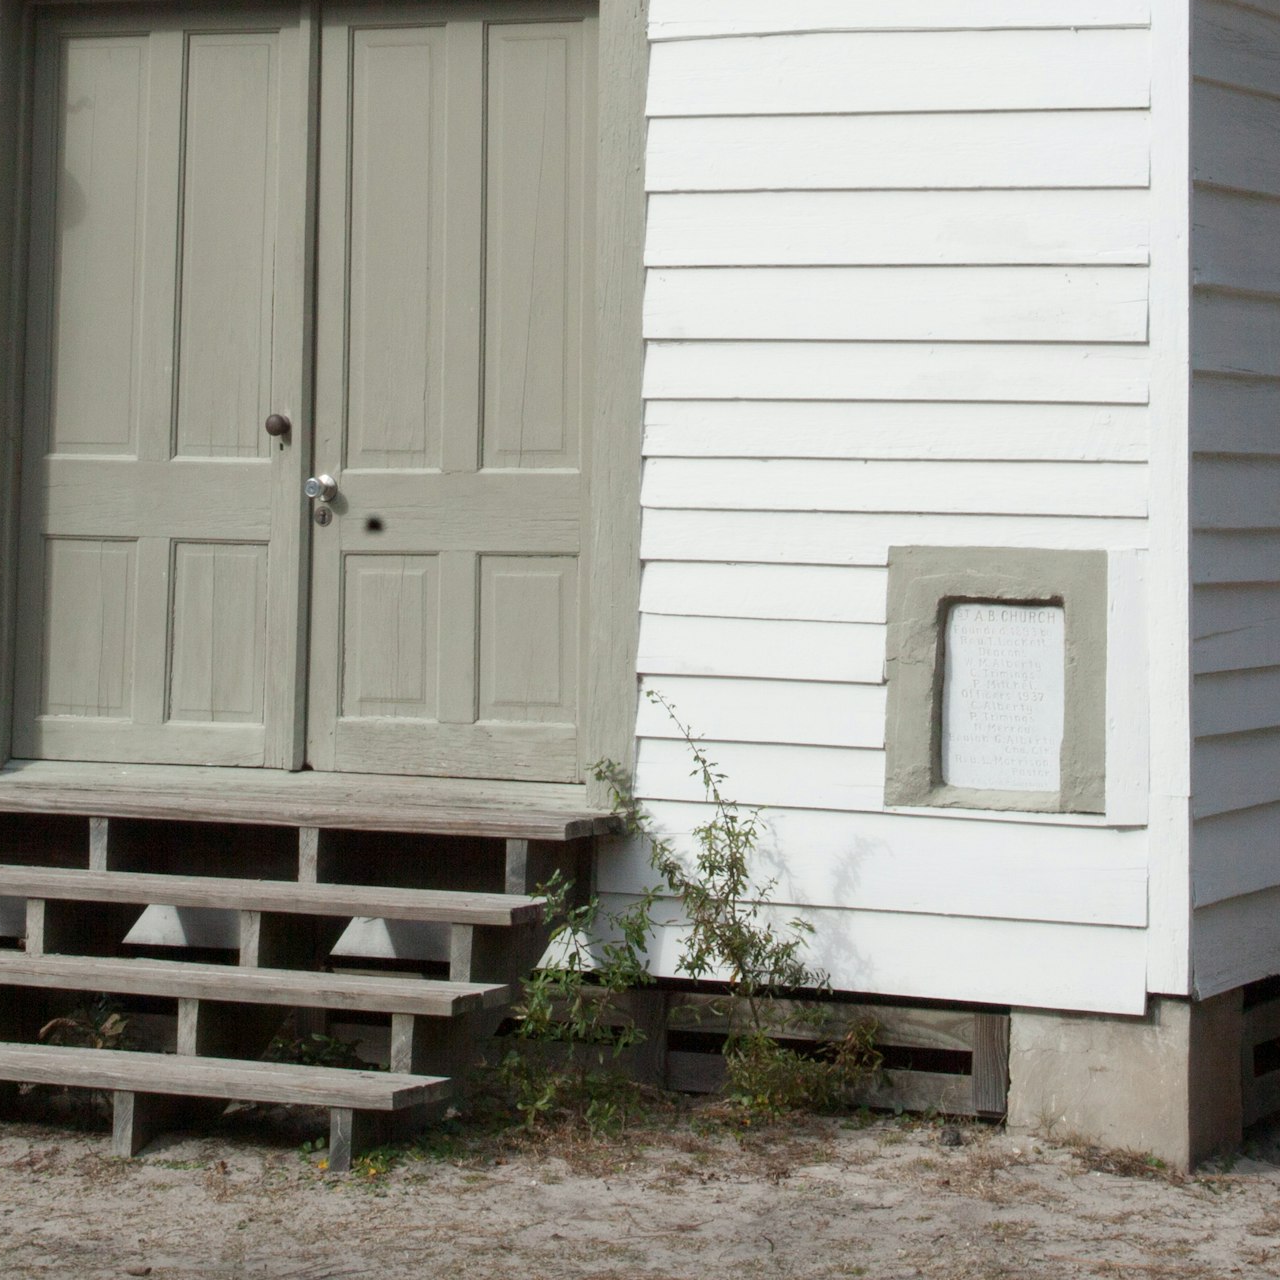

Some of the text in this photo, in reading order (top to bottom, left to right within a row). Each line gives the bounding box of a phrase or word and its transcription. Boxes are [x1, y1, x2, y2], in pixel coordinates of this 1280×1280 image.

[1000, 610, 1056, 625] CHURCH
[953, 624, 1006, 636] Founded
[1017, 691, 1045, 702] 1937
